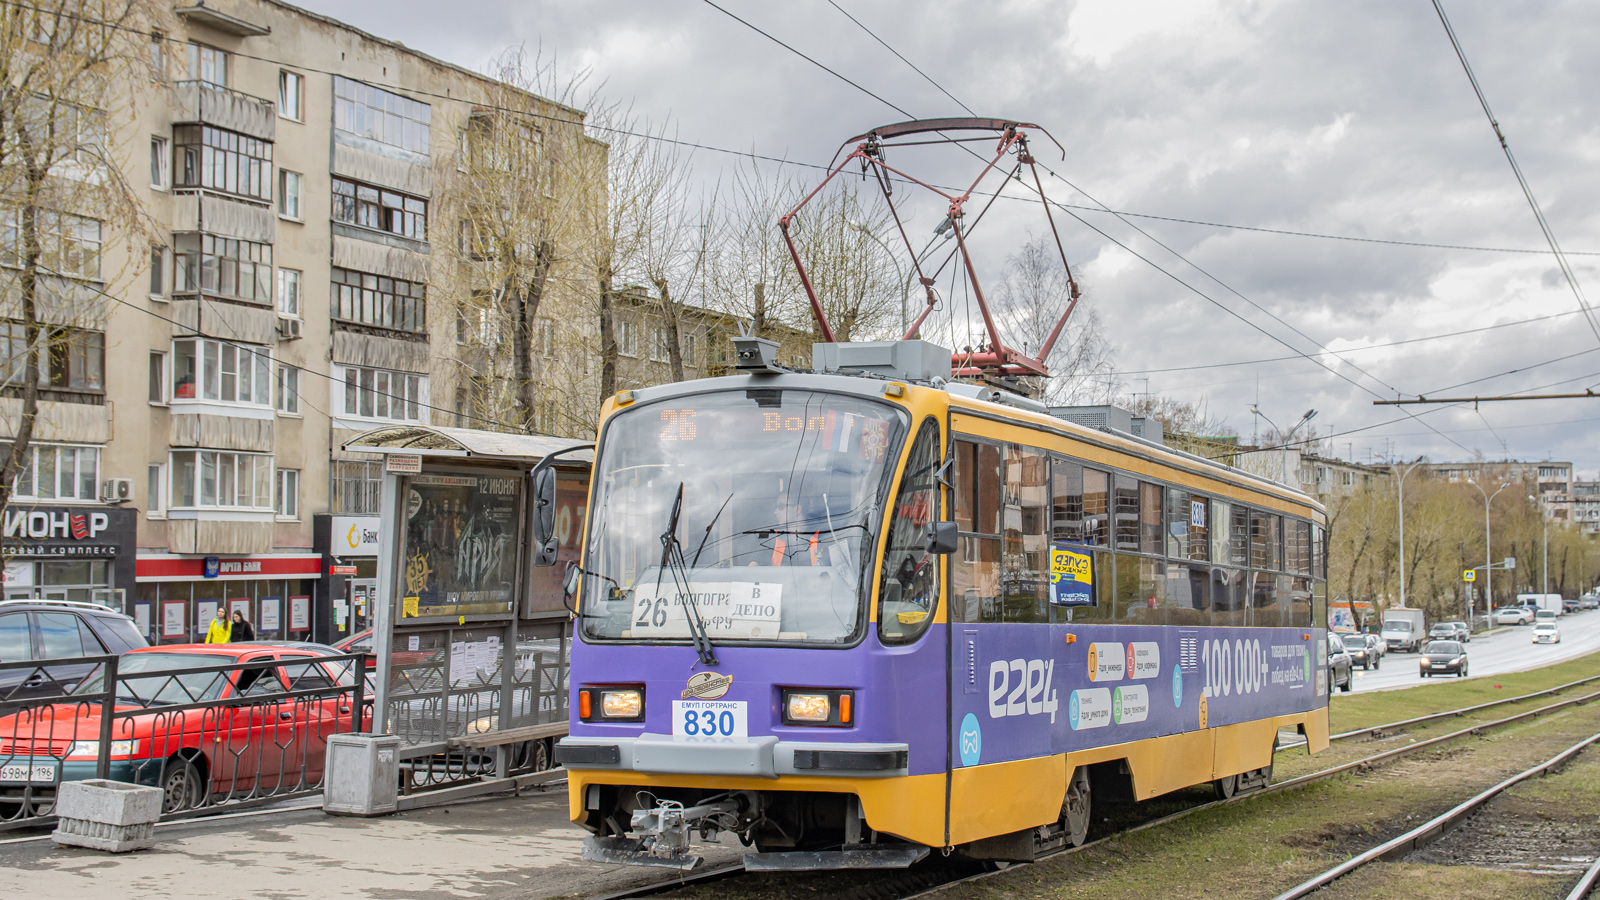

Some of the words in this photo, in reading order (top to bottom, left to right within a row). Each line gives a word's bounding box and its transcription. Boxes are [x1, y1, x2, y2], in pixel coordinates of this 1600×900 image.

[660, 409, 697, 441] 26
[479, 478, 488, 495] 12
[489, 478, 515, 495] ИЮНЯ
[1193, 503, 1204, 525] 830
[363, 529, 378, 544] Банк
[220, 562, 242, 573] ПОЧТА
[243, 561, 262, 572] БАНК
[409, 554, 424, 578] 35
[411, 574, 426, 593] ЛЕТ
[752, 587, 761, 599] В
[635, 597, 669, 628] 26
[732, 604, 775, 617] ДЕПО
[1202, 639, 1231, 697] 100
[988, 658, 1059, 725] e2e4
[684, 710, 735, 737] 830
